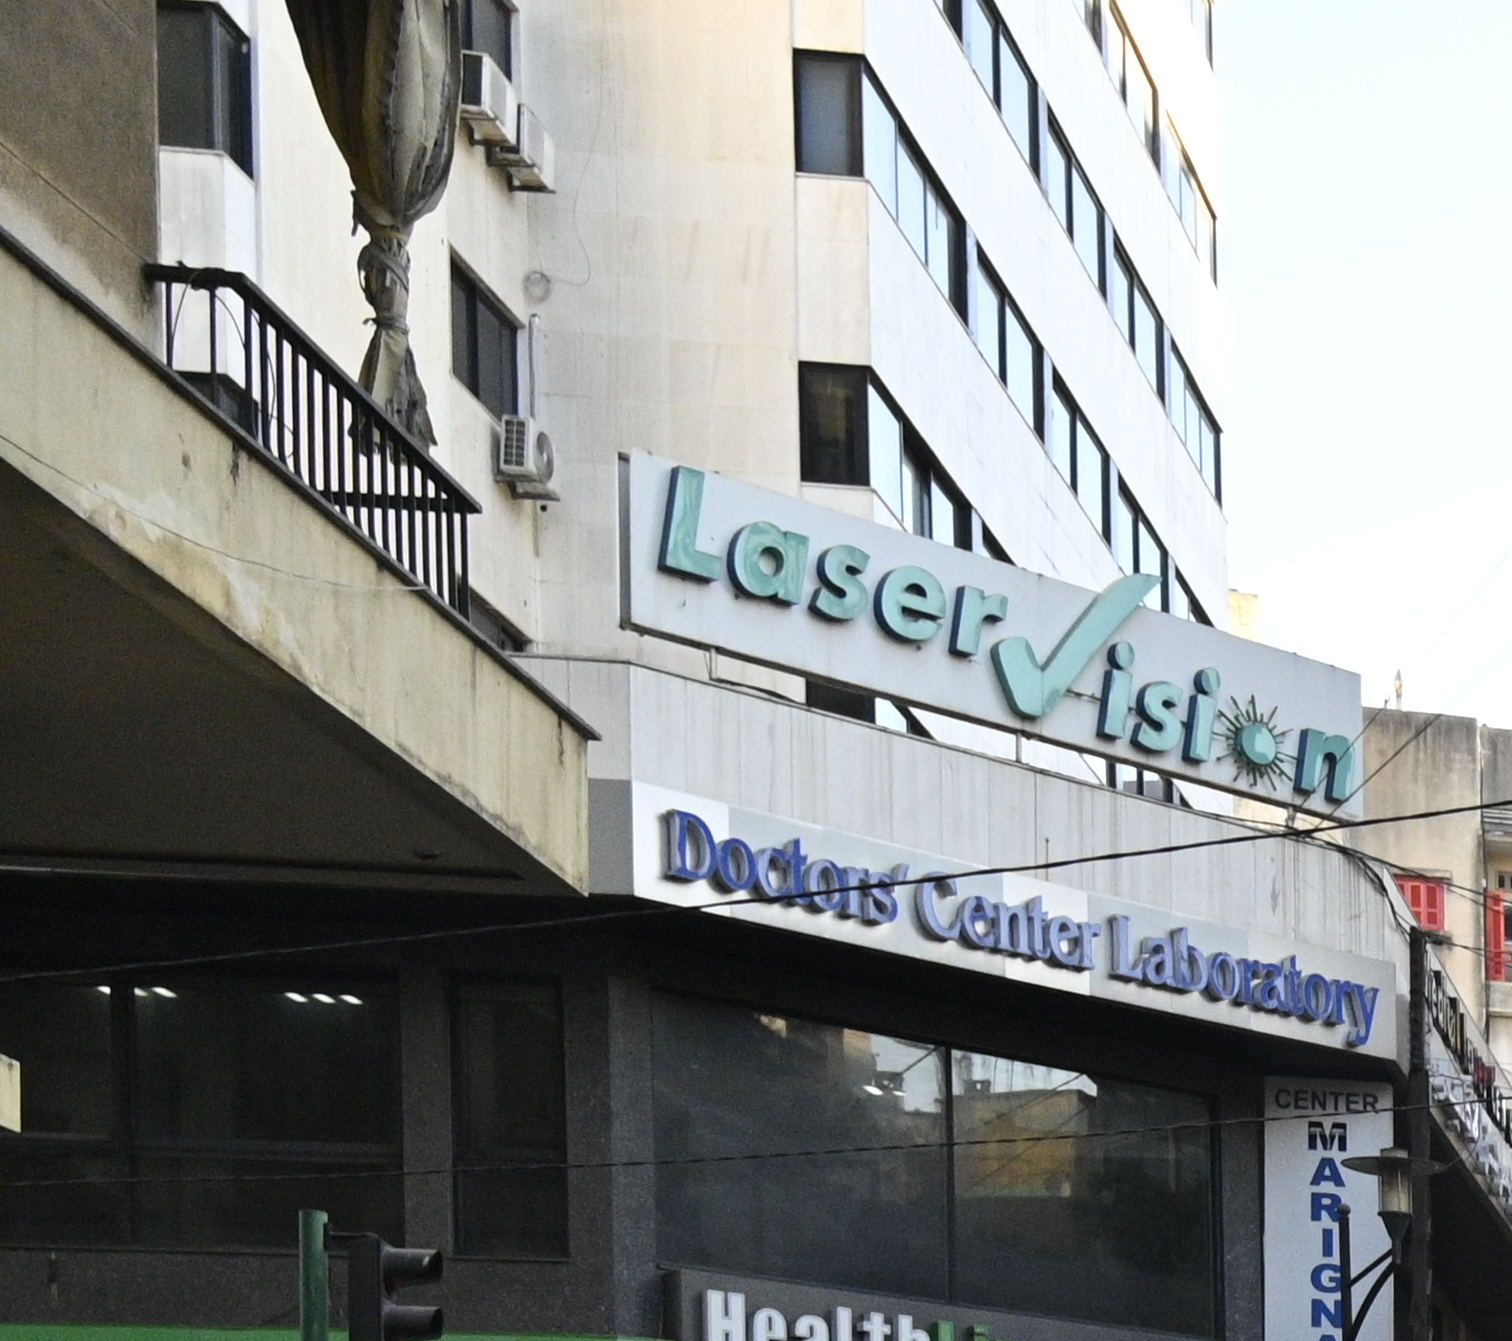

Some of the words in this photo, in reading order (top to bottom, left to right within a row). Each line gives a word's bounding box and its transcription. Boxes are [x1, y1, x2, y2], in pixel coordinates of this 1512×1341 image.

[659, 465, 1008, 658] Laser
[664, 808, 911, 927] Doctors'
[914, 873, 1102, 973] Center
[1109, 912, 1380, 1048] Laboratory
[1275, 1088, 1379, 1113] CENTER
